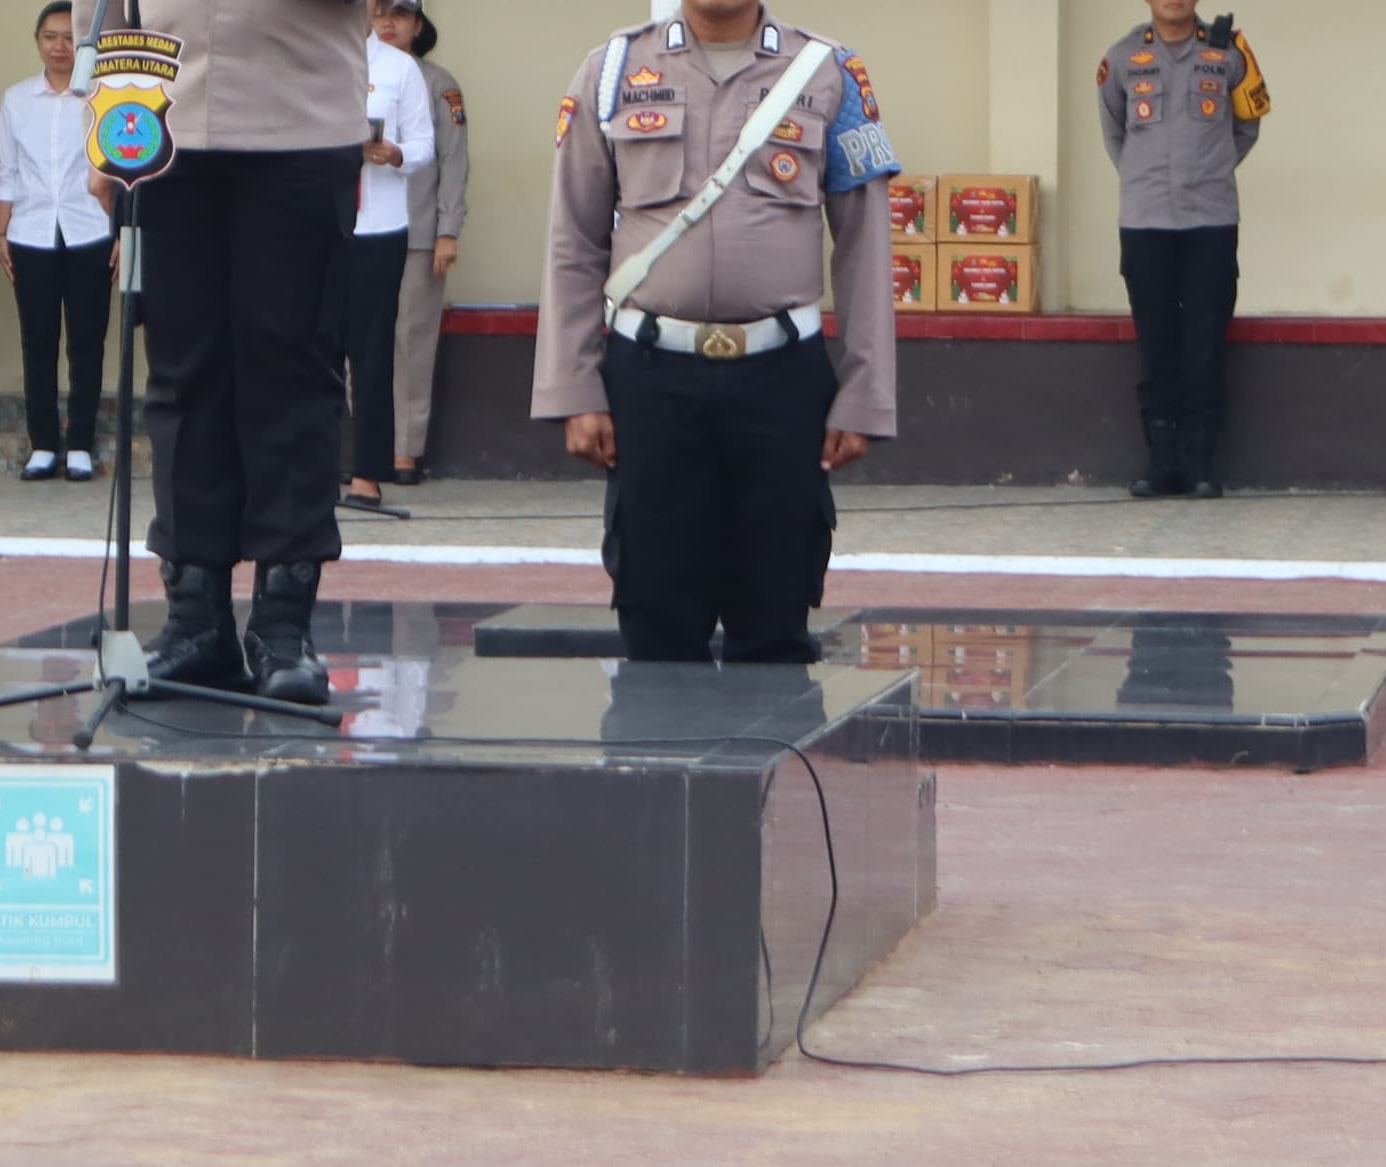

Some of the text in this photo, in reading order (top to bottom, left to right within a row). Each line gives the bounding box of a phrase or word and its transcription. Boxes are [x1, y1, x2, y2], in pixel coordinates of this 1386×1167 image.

[97, 35, 176, 52] LRESTABES MEDAN
[94, 59, 175, 78] UMATERA UTARA
[759, 87, 813, 108] PRI
[837, 122, 894, 176] PR
